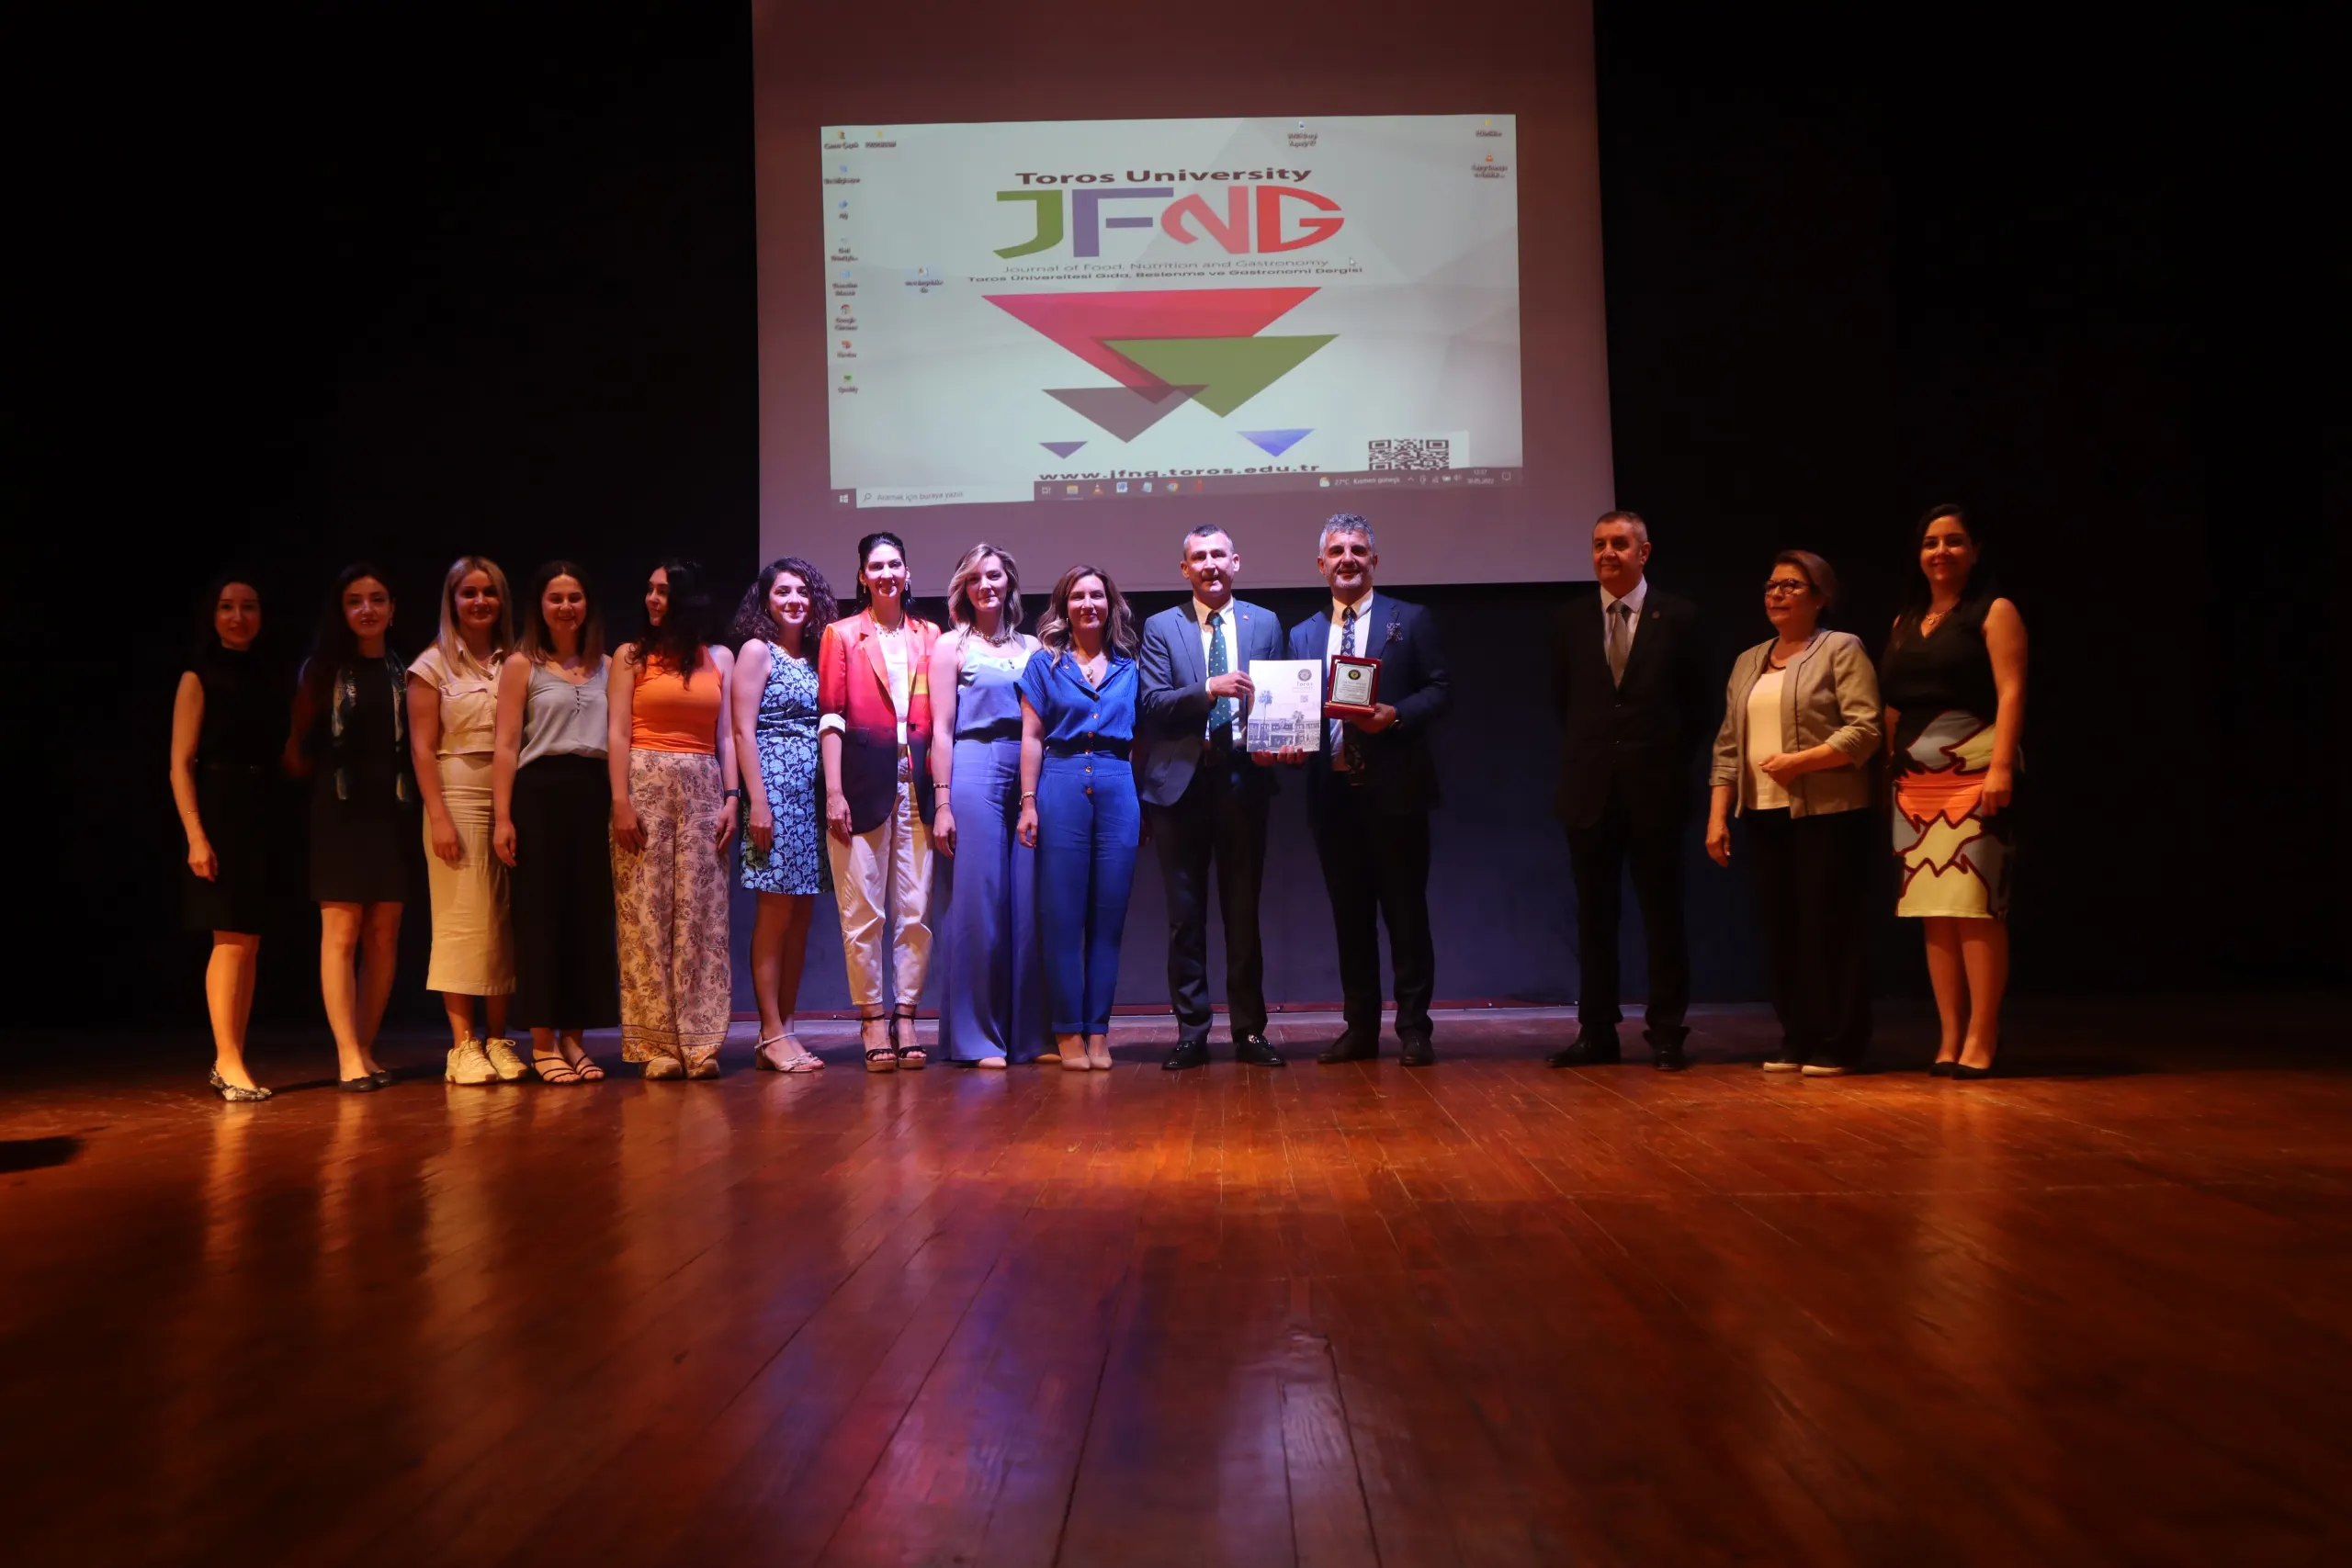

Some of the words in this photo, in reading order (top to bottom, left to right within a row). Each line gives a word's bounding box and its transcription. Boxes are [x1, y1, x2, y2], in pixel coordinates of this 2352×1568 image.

[1015, 170, 1115, 185] Toros
[1126, 166, 1312, 183] University
[1003, 265, 1059, 274] Journal
[1067, 263, 1080, 272] of
[1084, 263, 1125, 273] Food,
[1130, 261, 1198, 270] Nutrition
[1203, 260, 1231, 268] and
[1236, 258, 1329, 268] Gastronomy
[1136, 270, 1205, 278] Beslenme
[1229, 267, 1312, 276] Gastronomi
[1316, 266, 1363, 276] Dergisi
